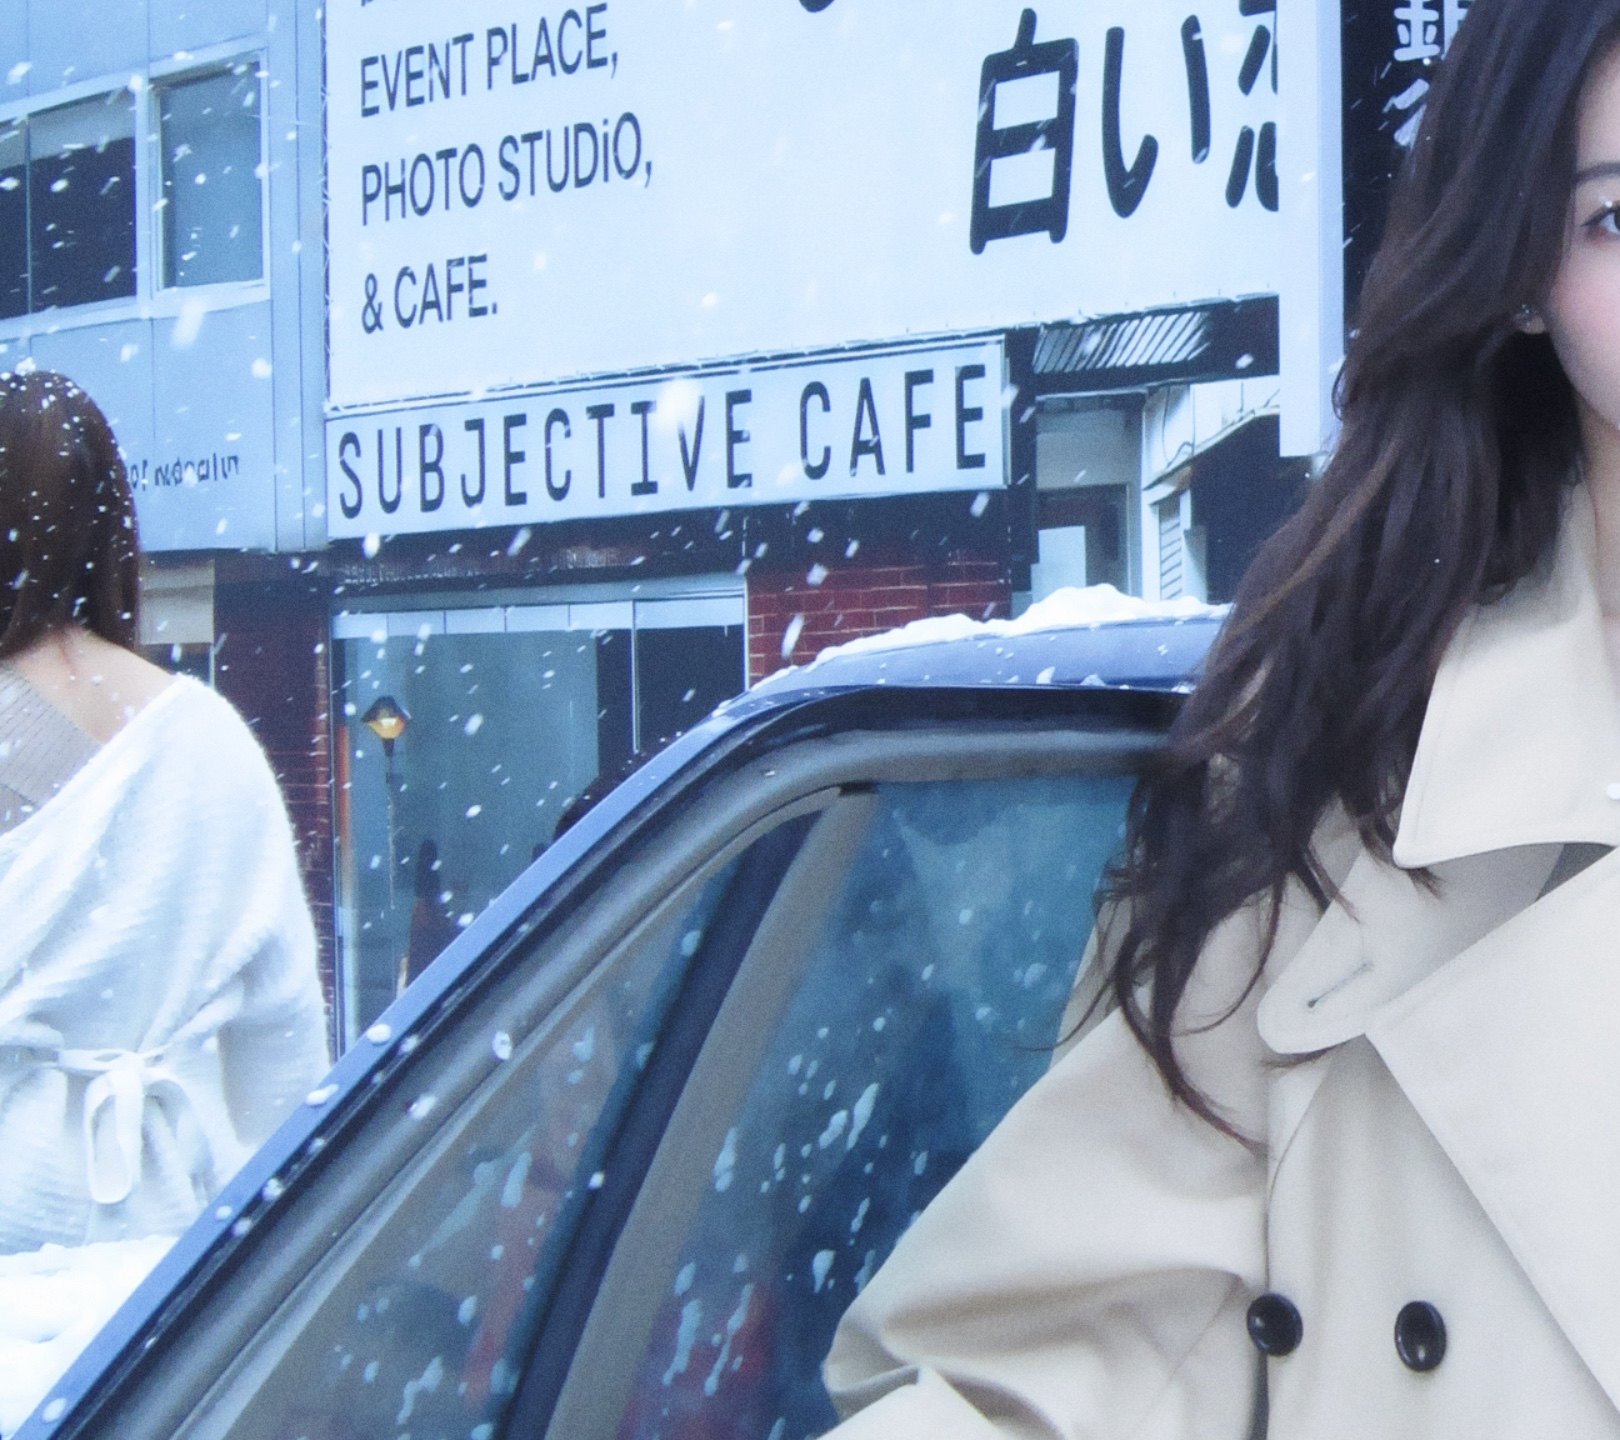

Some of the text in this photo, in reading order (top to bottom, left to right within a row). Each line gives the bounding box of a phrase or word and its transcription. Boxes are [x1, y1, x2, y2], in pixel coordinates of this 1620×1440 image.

[361, 2, 619, 118] EVENT PLACE,
[361, 142, 486, 227] PHOTO
[361, 253, 498, 335] & CAFE.
[337, 363, 987, 520] SUBJECTIVE CAFE
